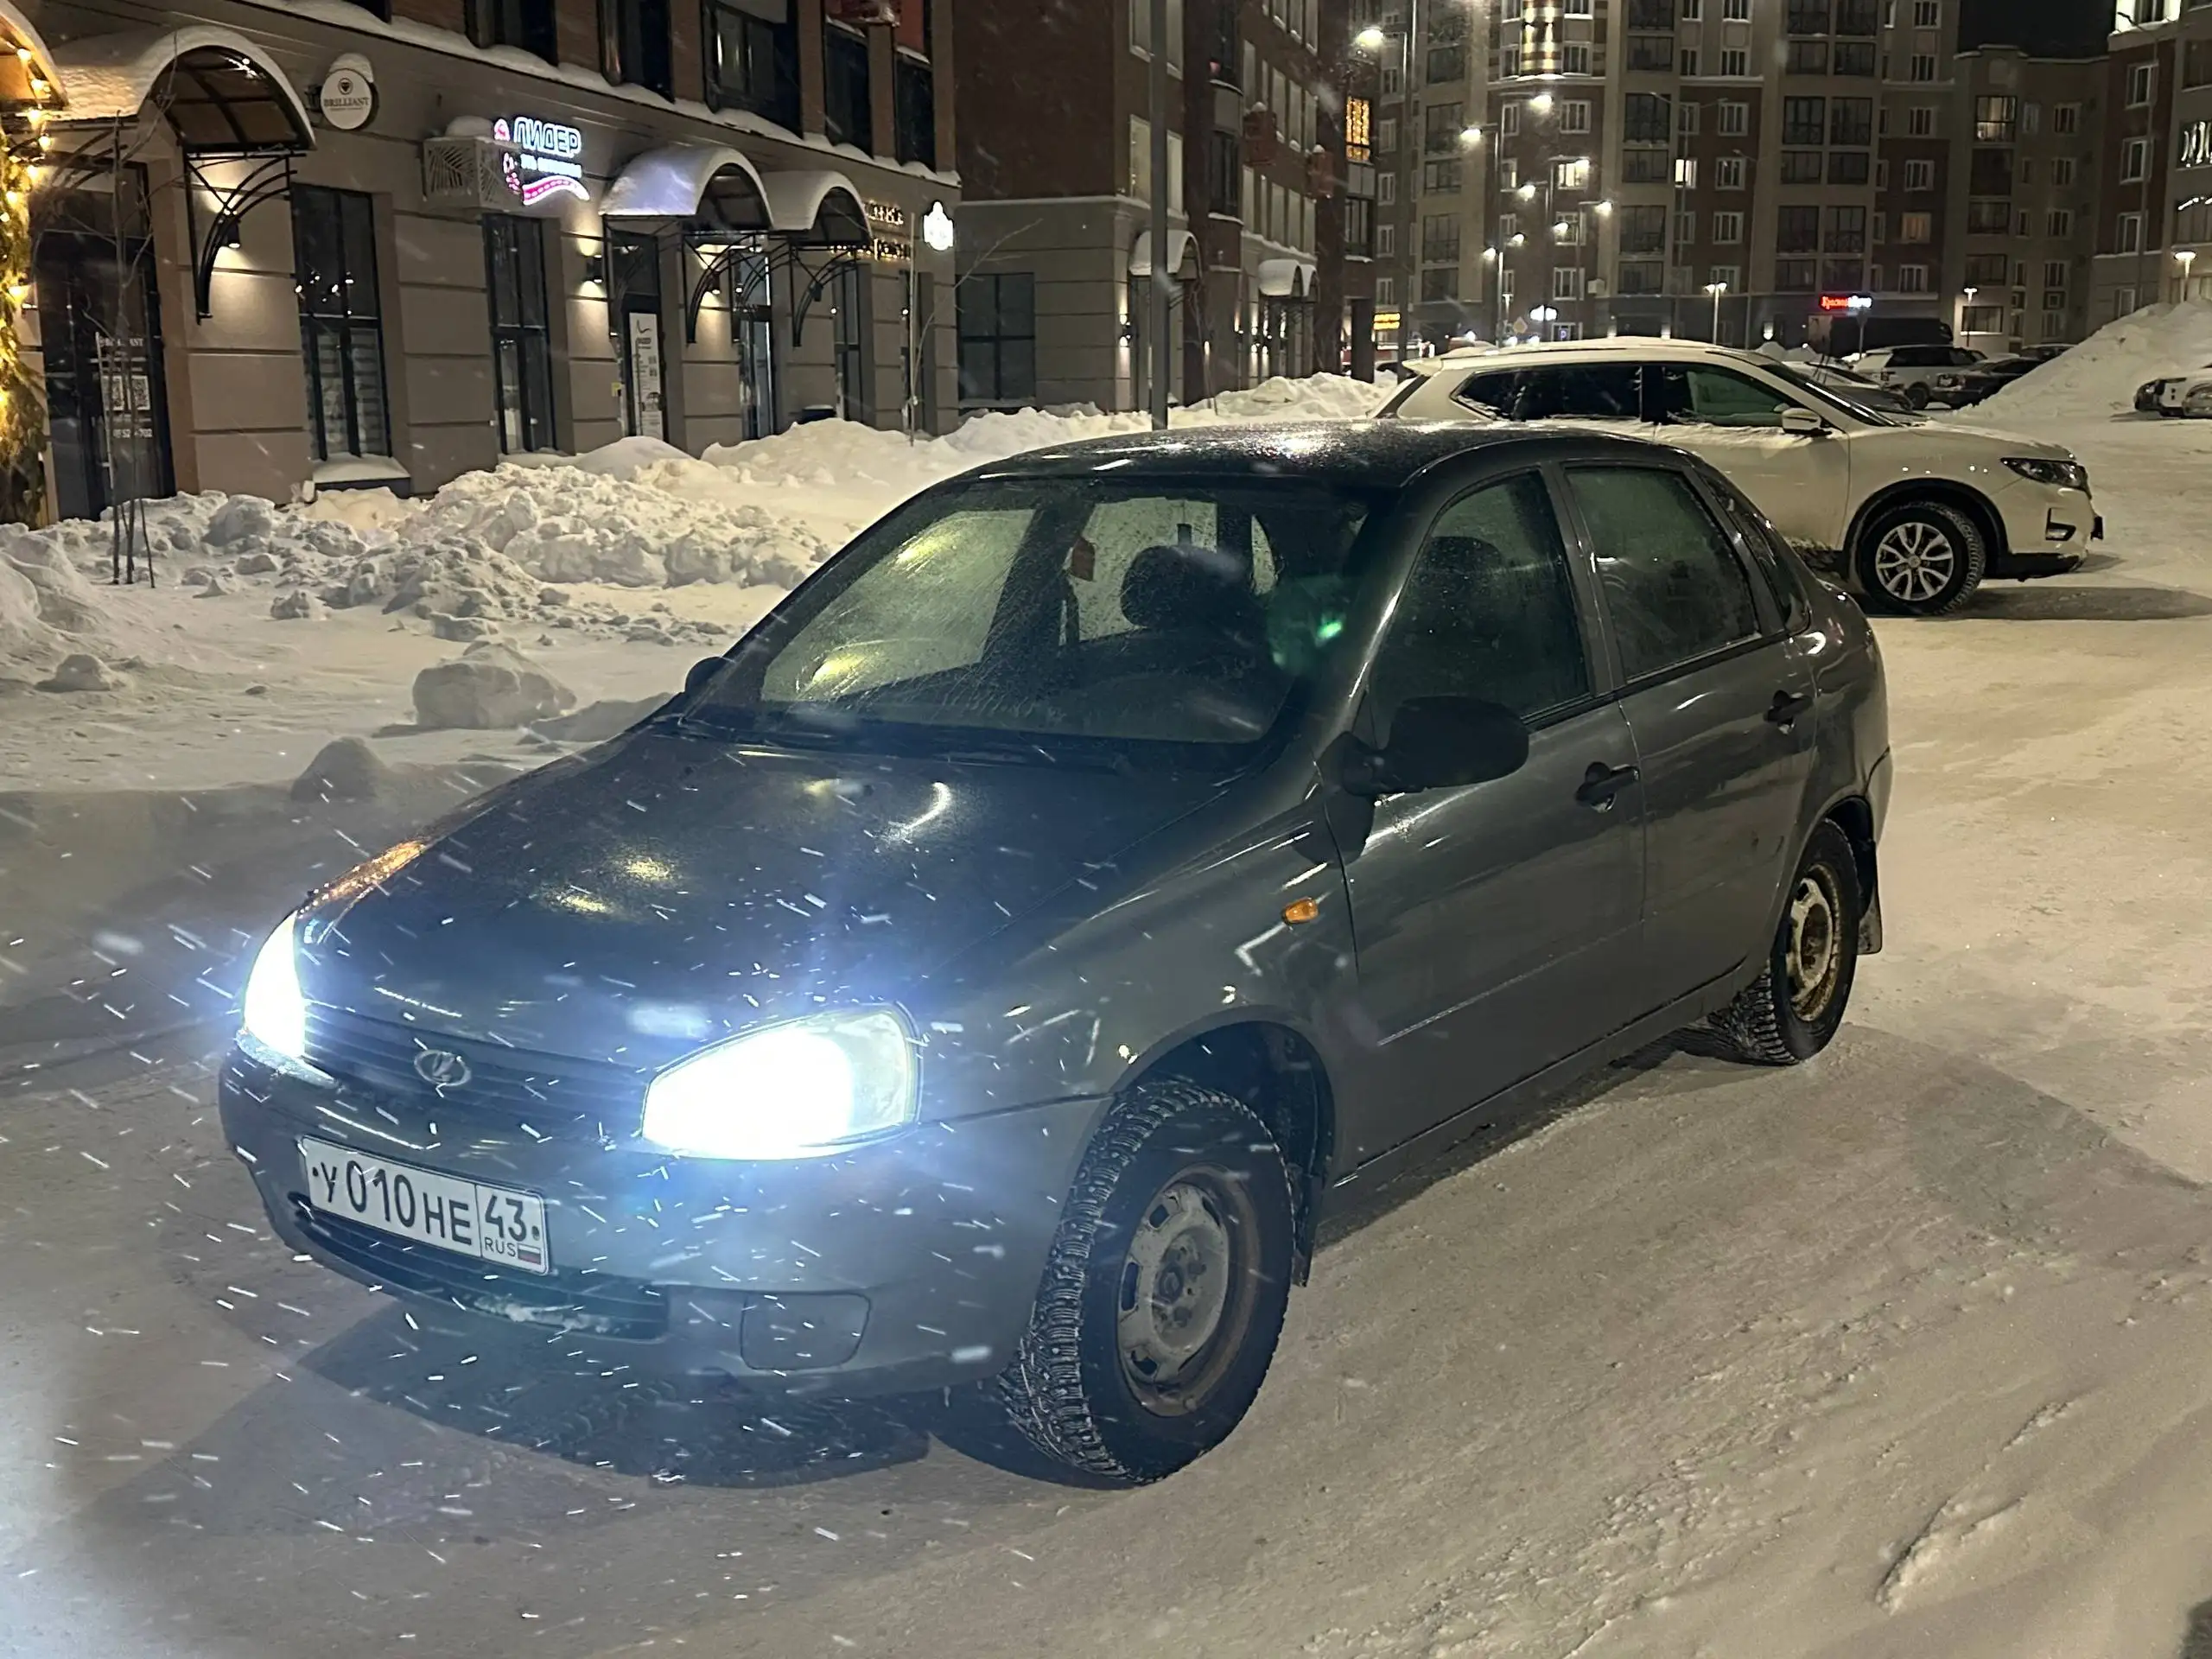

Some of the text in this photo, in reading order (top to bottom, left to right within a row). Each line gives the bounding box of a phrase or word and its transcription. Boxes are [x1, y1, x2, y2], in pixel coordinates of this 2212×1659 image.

[324, 96, 370, 106] BRILLIANT
[513, 117, 582, 158] ЛИДЕР
[485, 1195, 527, 1242] 43
[485, 1236, 516, 1257] RUS
